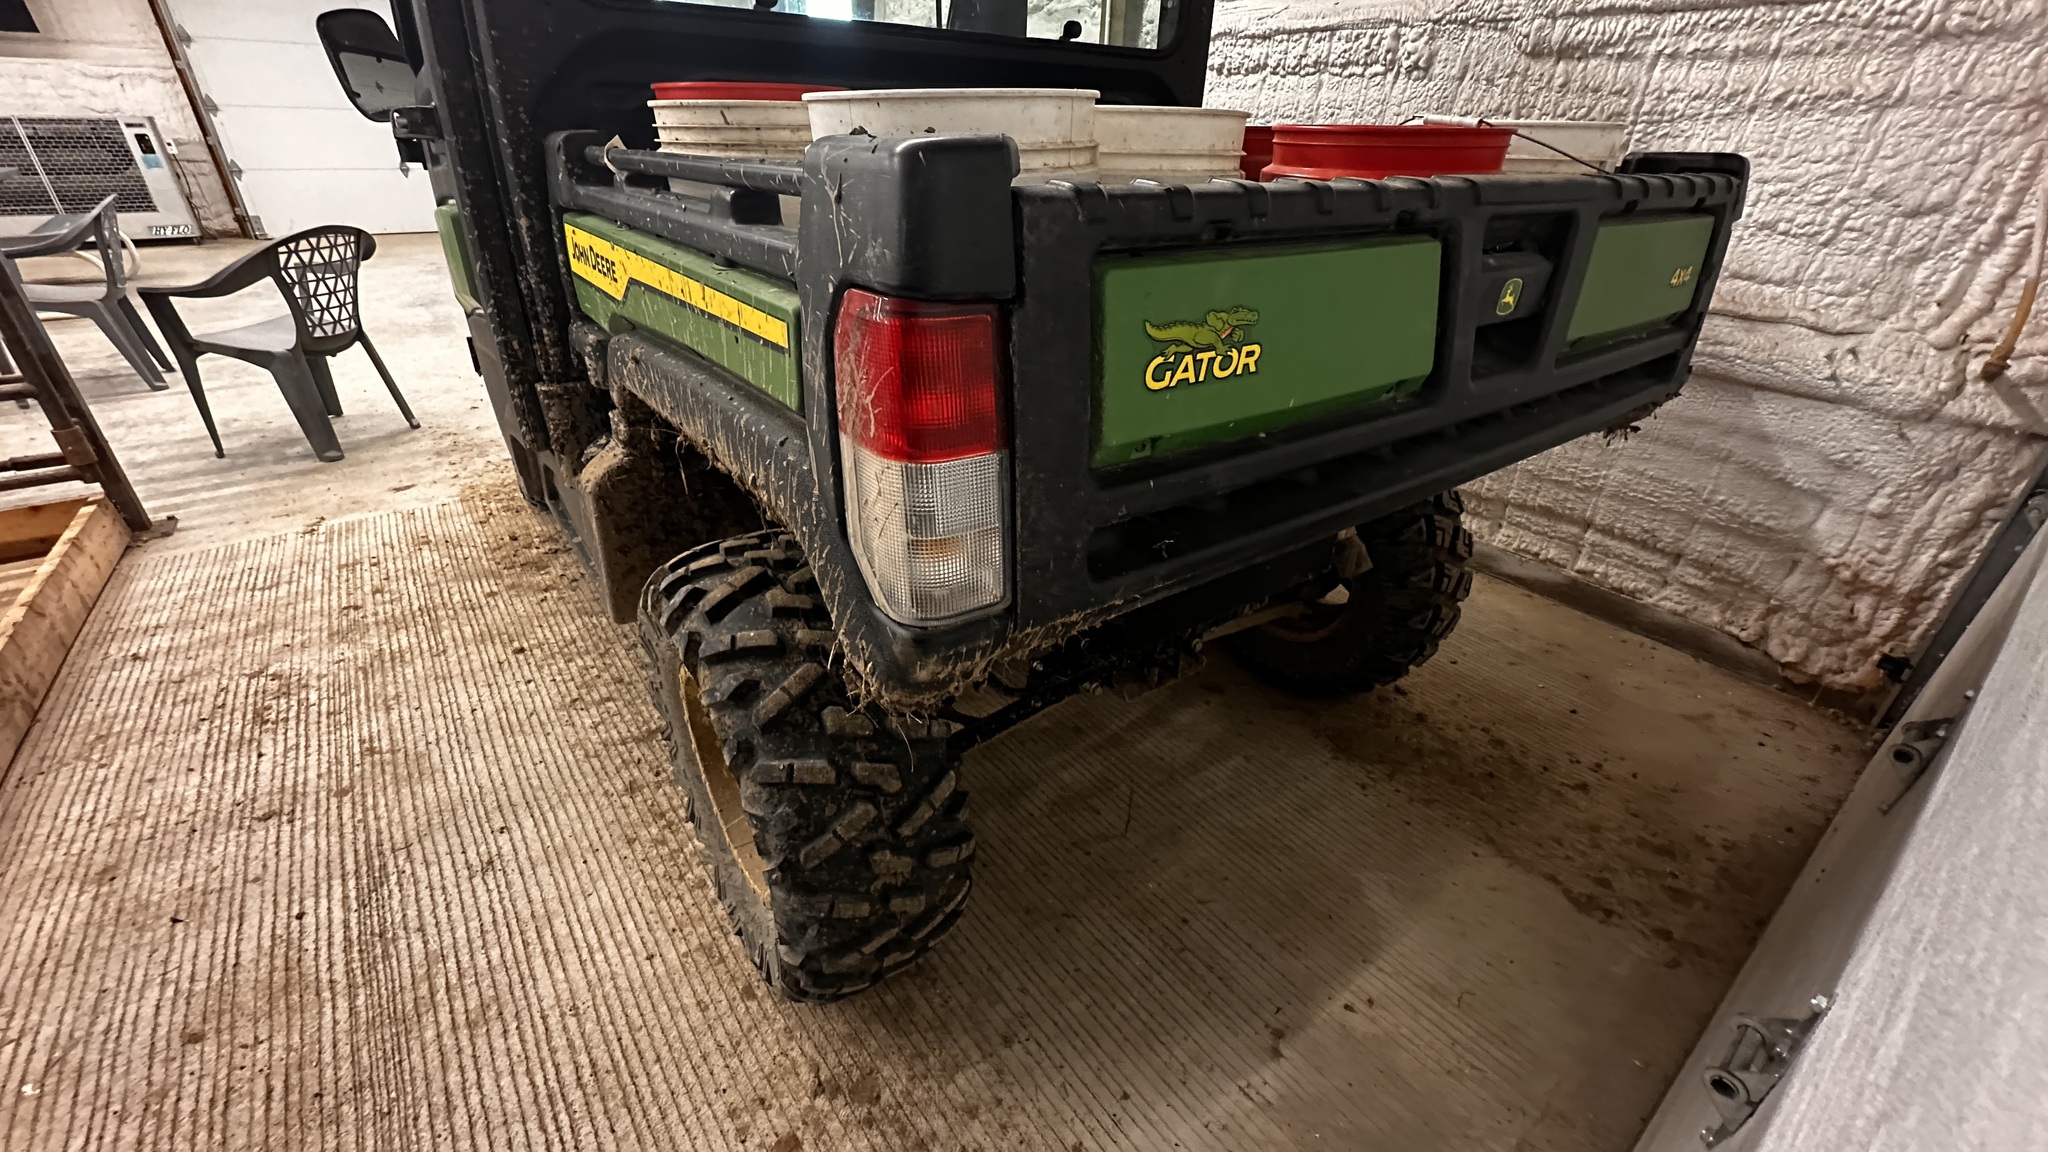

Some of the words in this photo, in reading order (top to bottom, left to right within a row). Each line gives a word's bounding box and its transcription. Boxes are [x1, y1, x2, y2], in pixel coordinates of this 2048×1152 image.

[571, 236, 591, 267] JOHN
[589, 245, 618, 283] DEERE
[1144, 343, 1261, 391] GATOR
